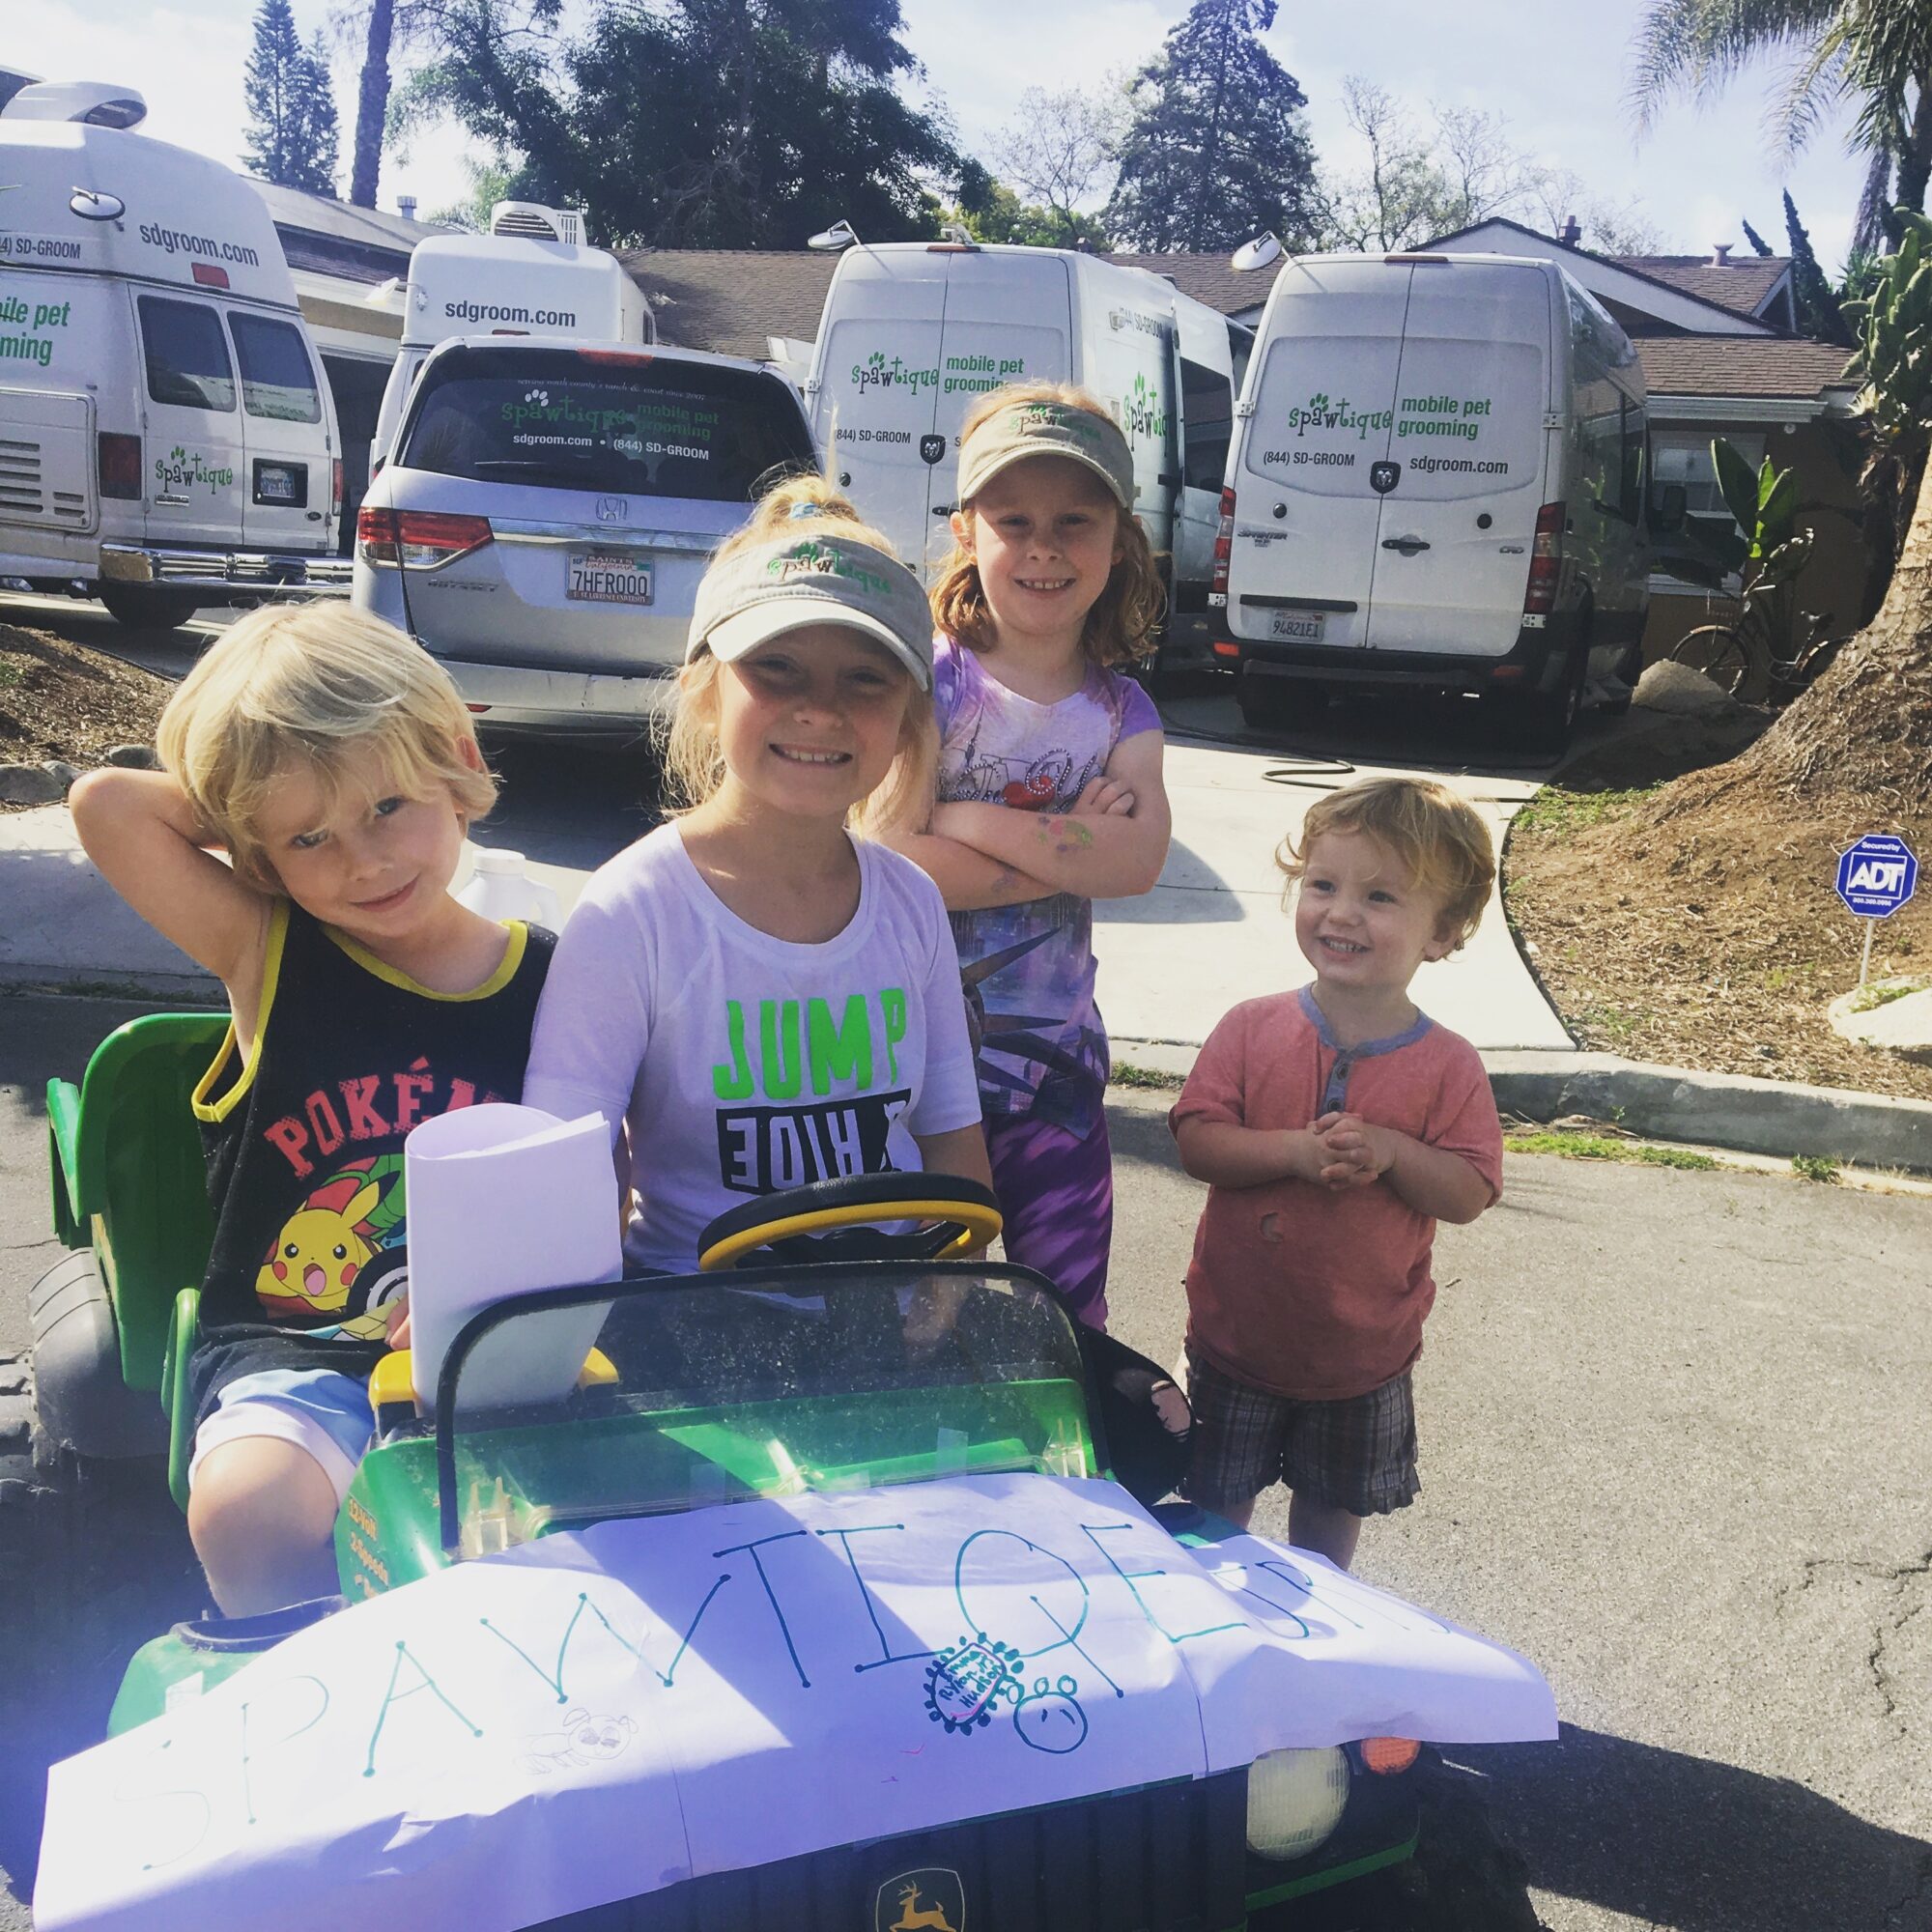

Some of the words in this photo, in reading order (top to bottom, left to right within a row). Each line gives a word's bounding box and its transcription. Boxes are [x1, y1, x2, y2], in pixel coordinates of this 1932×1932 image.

[15, 240, 81, 260] SD-GROOM
[140, 223, 259, 267] sdgroom.com
[34, 301, 71, 329] pet
[445, 299, 576, 327] sdgroom.com
[852, 355, 940, 396] spawtique
[946, 355, 996, 372] mobile
[1000, 357, 1024, 375] pet
[637, 403, 690, 419] mobile
[694, 410, 720, 425] pet
[1289, 397, 1392, 440] spawtique
[1401, 395, 1459, 414] mobile
[1463, 397, 1492, 417] pet
[635, 416, 712, 441] grooming
[859, 430, 911, 443] SD-GROOM
[1397, 418, 1479, 440] grooming
[513, 434, 593, 447] sdgroom.com
[613, 440, 643, 453] (844)
[645, 442, 710, 461] SD-GROOM
[1263, 451, 1291, 467] (844)
[1293, 451, 1355, 467] SD-GROOM
[156, 453, 233, 495] spawtique
[1409, 455, 1509, 474] sdgroom.com
[1273, 620, 1319, 638] 94821E1
[1848, 862, 1906, 892] ADT
[712, 987, 907, 1100] JUMP
[959, 1663, 1004, 1709] Hudson
